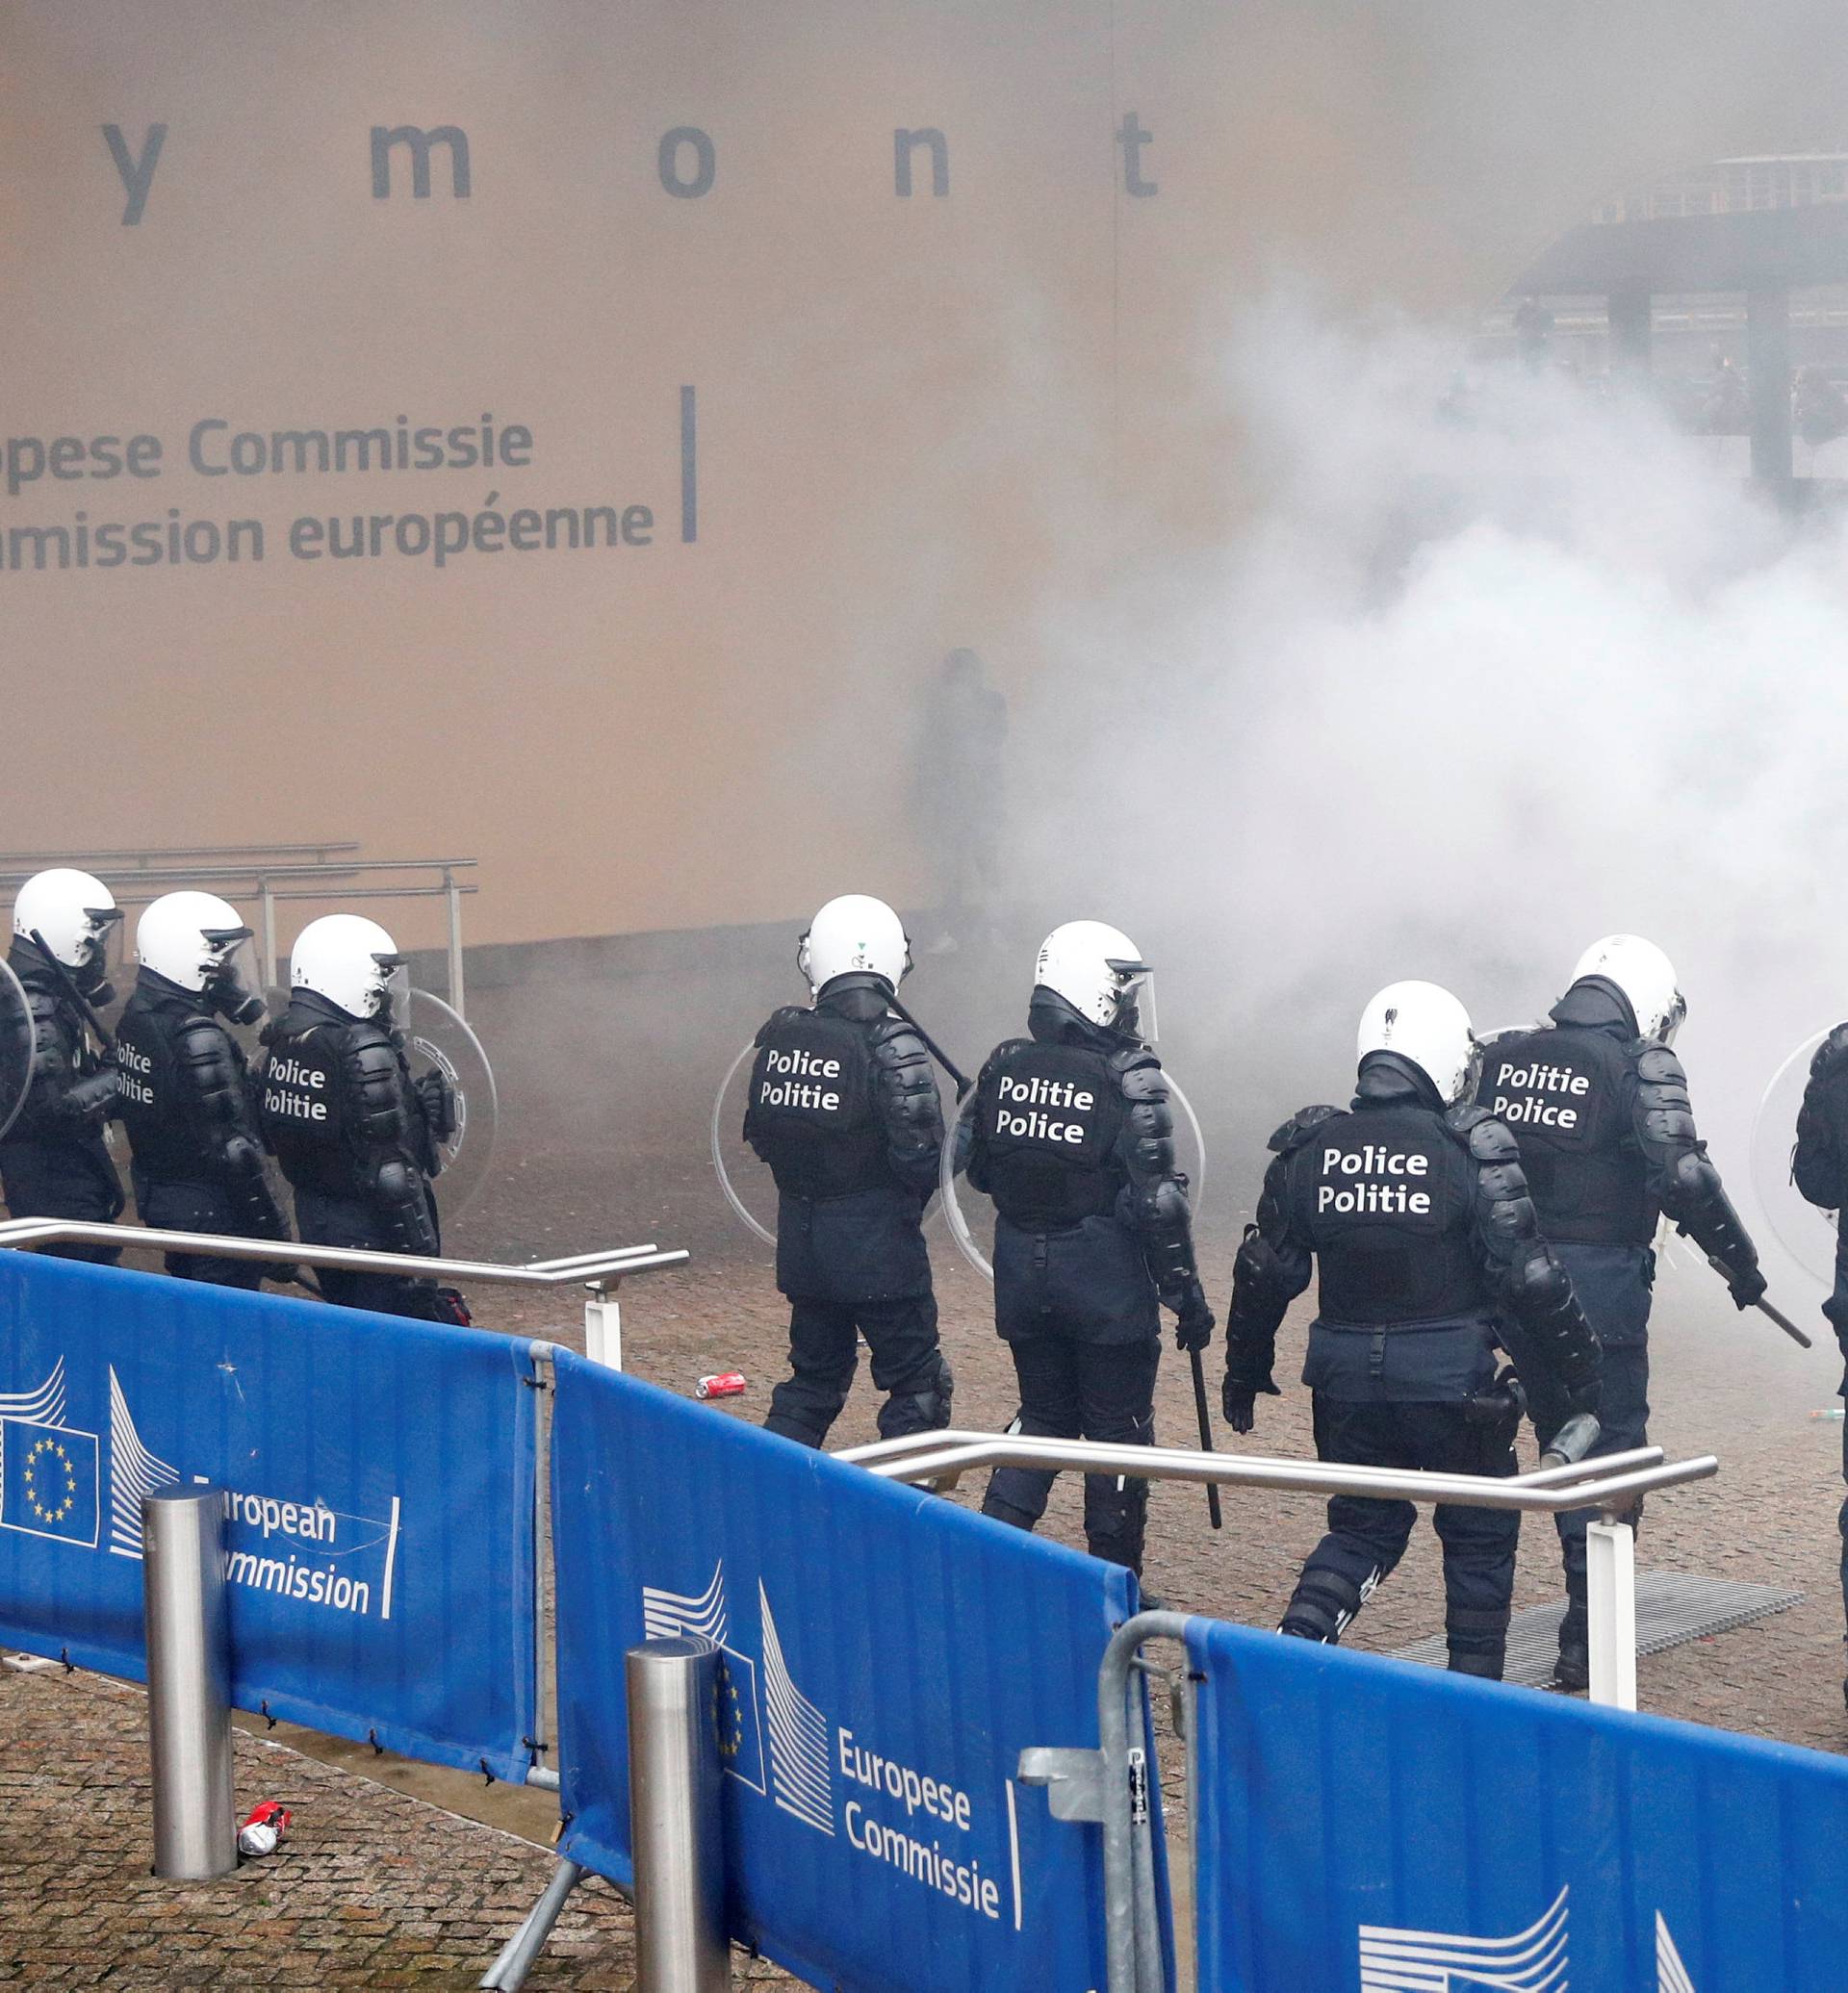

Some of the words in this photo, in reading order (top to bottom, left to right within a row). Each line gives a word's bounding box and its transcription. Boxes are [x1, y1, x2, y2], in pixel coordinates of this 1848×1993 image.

[0, 436, 163, 497] pese
[189, 414, 533, 476] Commissie
[0, 508, 264, 571] mission
[289, 491, 654, 568] européenne
[269, 1057, 325, 1088] Police
[766, 1049, 841, 1079] Police
[1496, 1063, 1589, 1095] Politie
[116, 1071, 154, 1104] olitie
[265, 1087, 327, 1120] Politie
[760, 1081, 840, 1111] Politie
[998, 1076, 1094, 1112] Politie
[995, 1110, 1085, 1145] Police
[1493, 1096, 1578, 1129] Police
[1322, 1145, 1428, 1176] Police
[1317, 1184, 1431, 1214] Politie
[838, 1726, 970, 1830] Europese
[845, 1801, 999, 1919] Commissie
